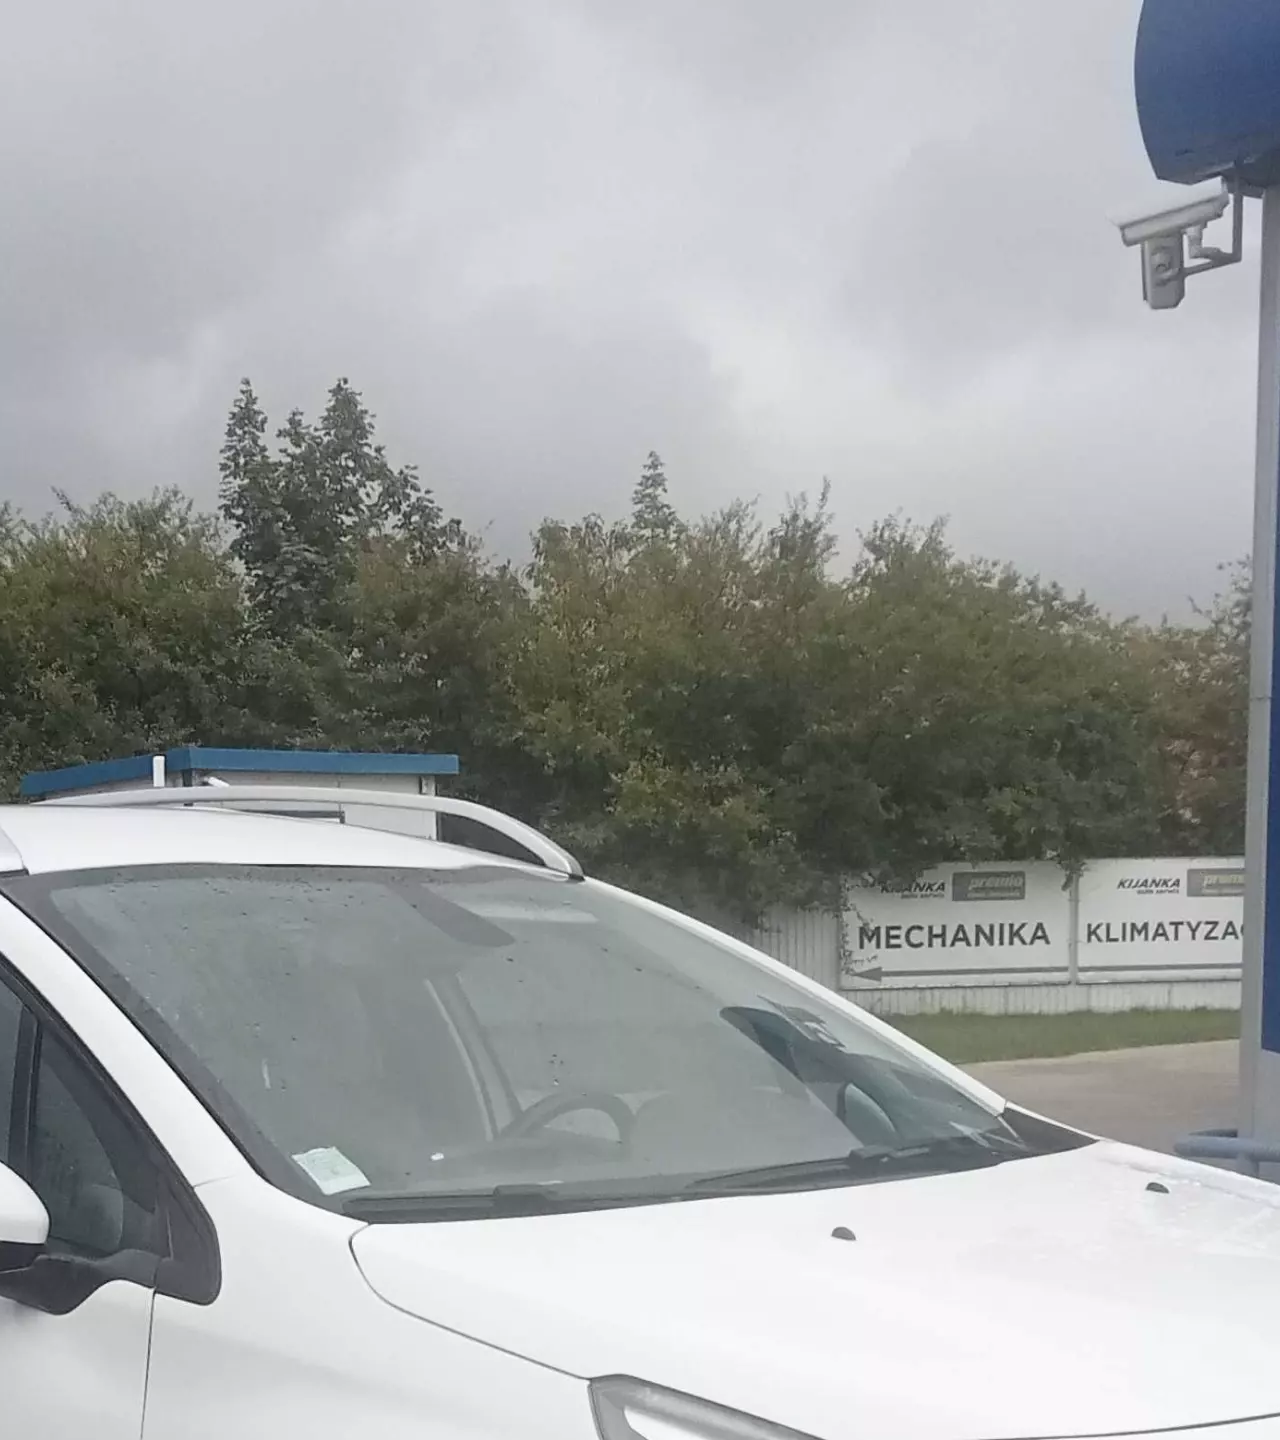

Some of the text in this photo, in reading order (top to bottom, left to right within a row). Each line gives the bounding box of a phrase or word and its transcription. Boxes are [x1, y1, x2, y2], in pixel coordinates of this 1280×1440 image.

[1117, 878, 1181, 889] KIJANKA
[858, 922, 1051, 950] MECHANIKA
[1086, 920, 1244, 943] KLIMATYZA
